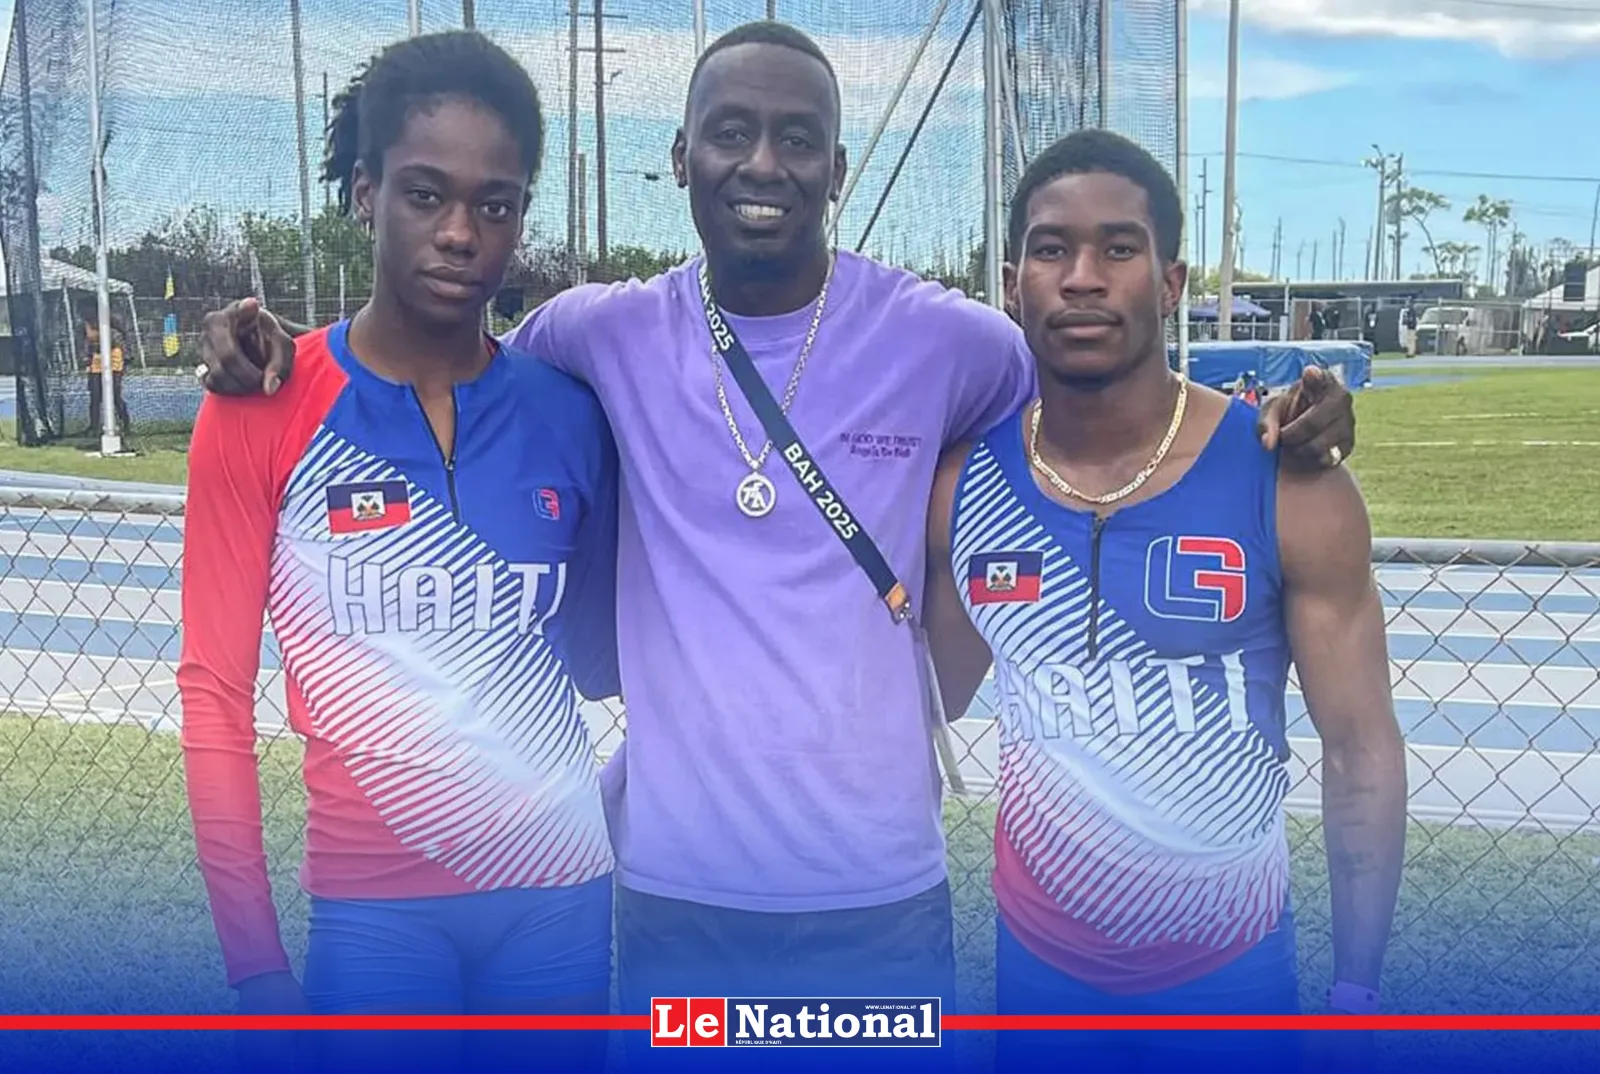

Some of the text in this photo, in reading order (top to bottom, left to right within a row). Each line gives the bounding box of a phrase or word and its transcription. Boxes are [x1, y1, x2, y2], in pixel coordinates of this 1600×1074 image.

[706, 302, 735, 351] 2025
[783, 442, 859, 539] BAH 2025
[327, 553, 567, 637] HAITI
